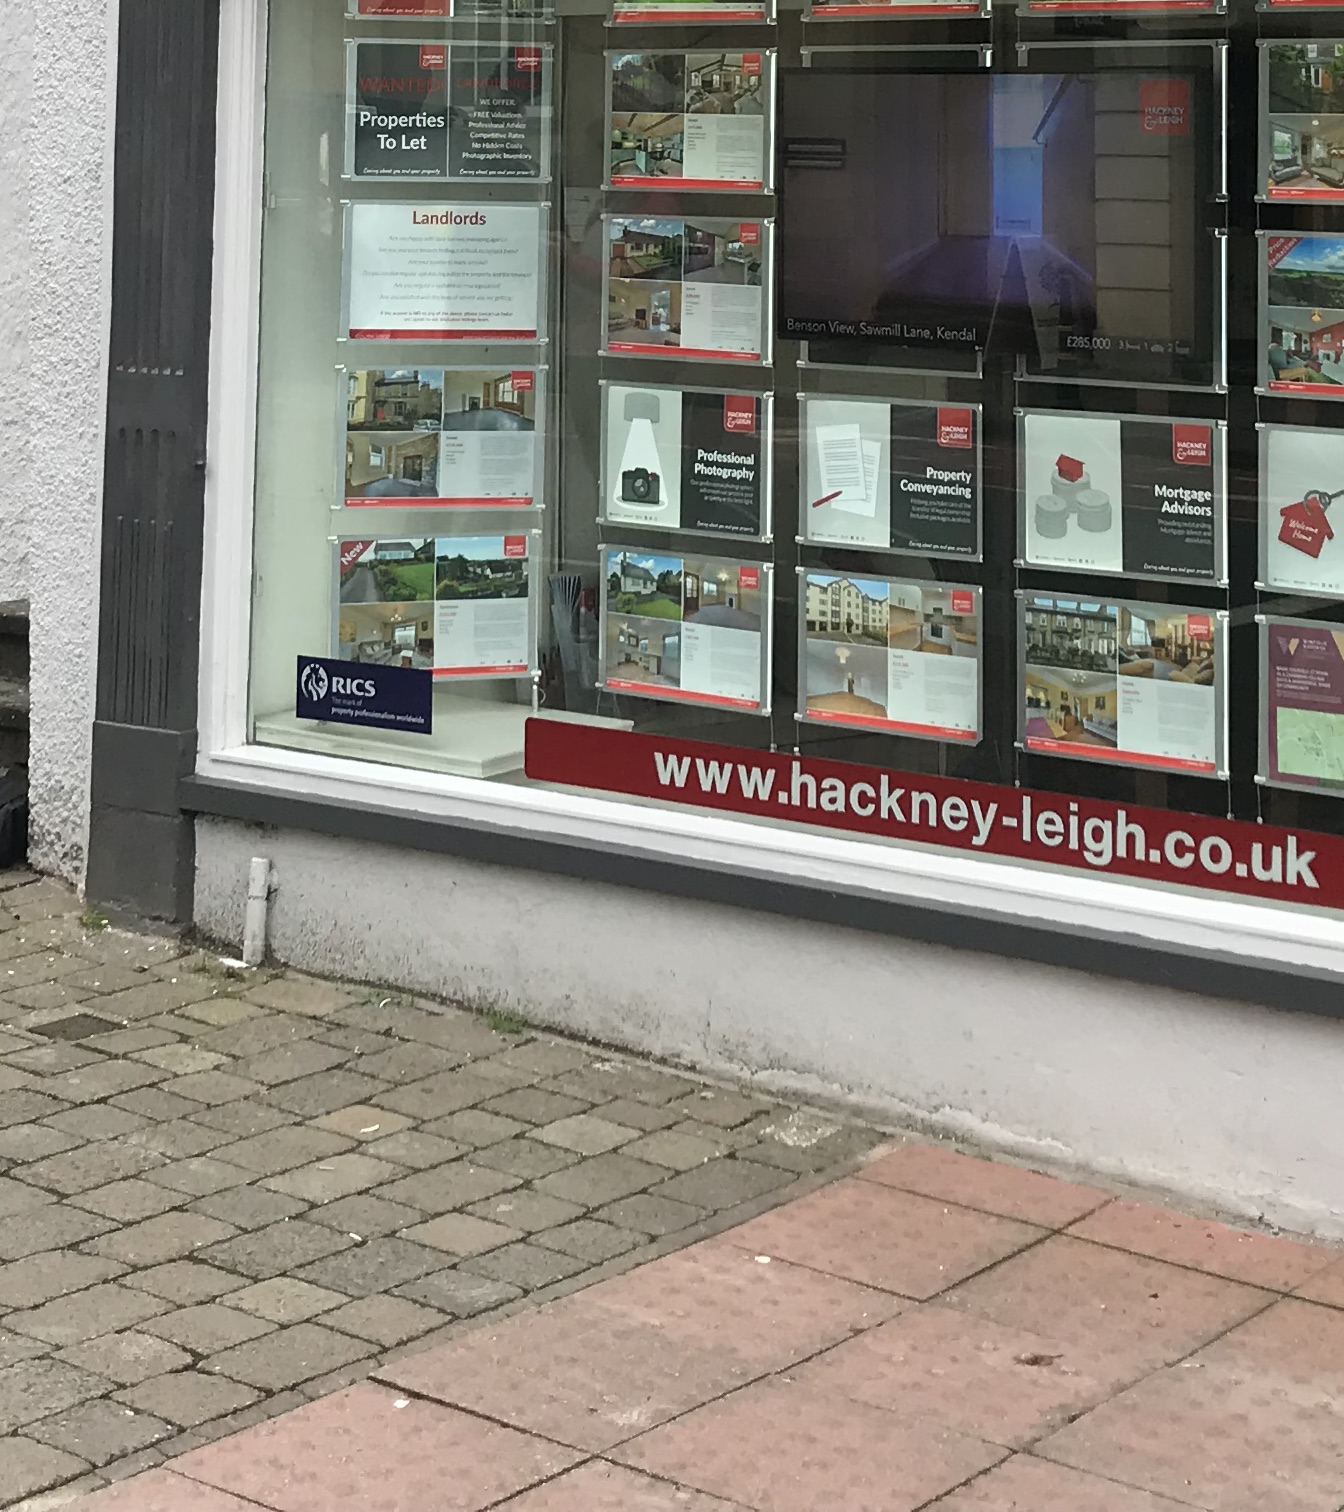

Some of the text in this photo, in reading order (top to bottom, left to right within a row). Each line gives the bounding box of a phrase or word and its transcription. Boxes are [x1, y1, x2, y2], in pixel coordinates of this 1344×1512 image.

[359, 111, 445, 129] Properties
[376, 134, 427, 150] To Let
[413, 210, 487, 226] Landlords
[787, 318, 976, 341] Benson View, Sawmill Lane, Kendal
[1067, 336, 1111, 350] £285,000
[697, 449, 754, 465] Professional
[694, 463, 755, 481] Photography
[926, 467, 972, 484] Property
[900, 479, 972, 499] Conveyancing
[1155, 485, 1212, 501] Mortgage
[1162, 500, 1212, 516] Advisors
[1289, 519, 1318, 534] Welcome
[1292, 530, 1312, 542] Home
[341, 541, 364, 566] New
[332, 676, 376, 697] RICS
[331, 707, 354, 716] property
[653, 751, 1320, 889] www.hackney-leigh.co.uk
